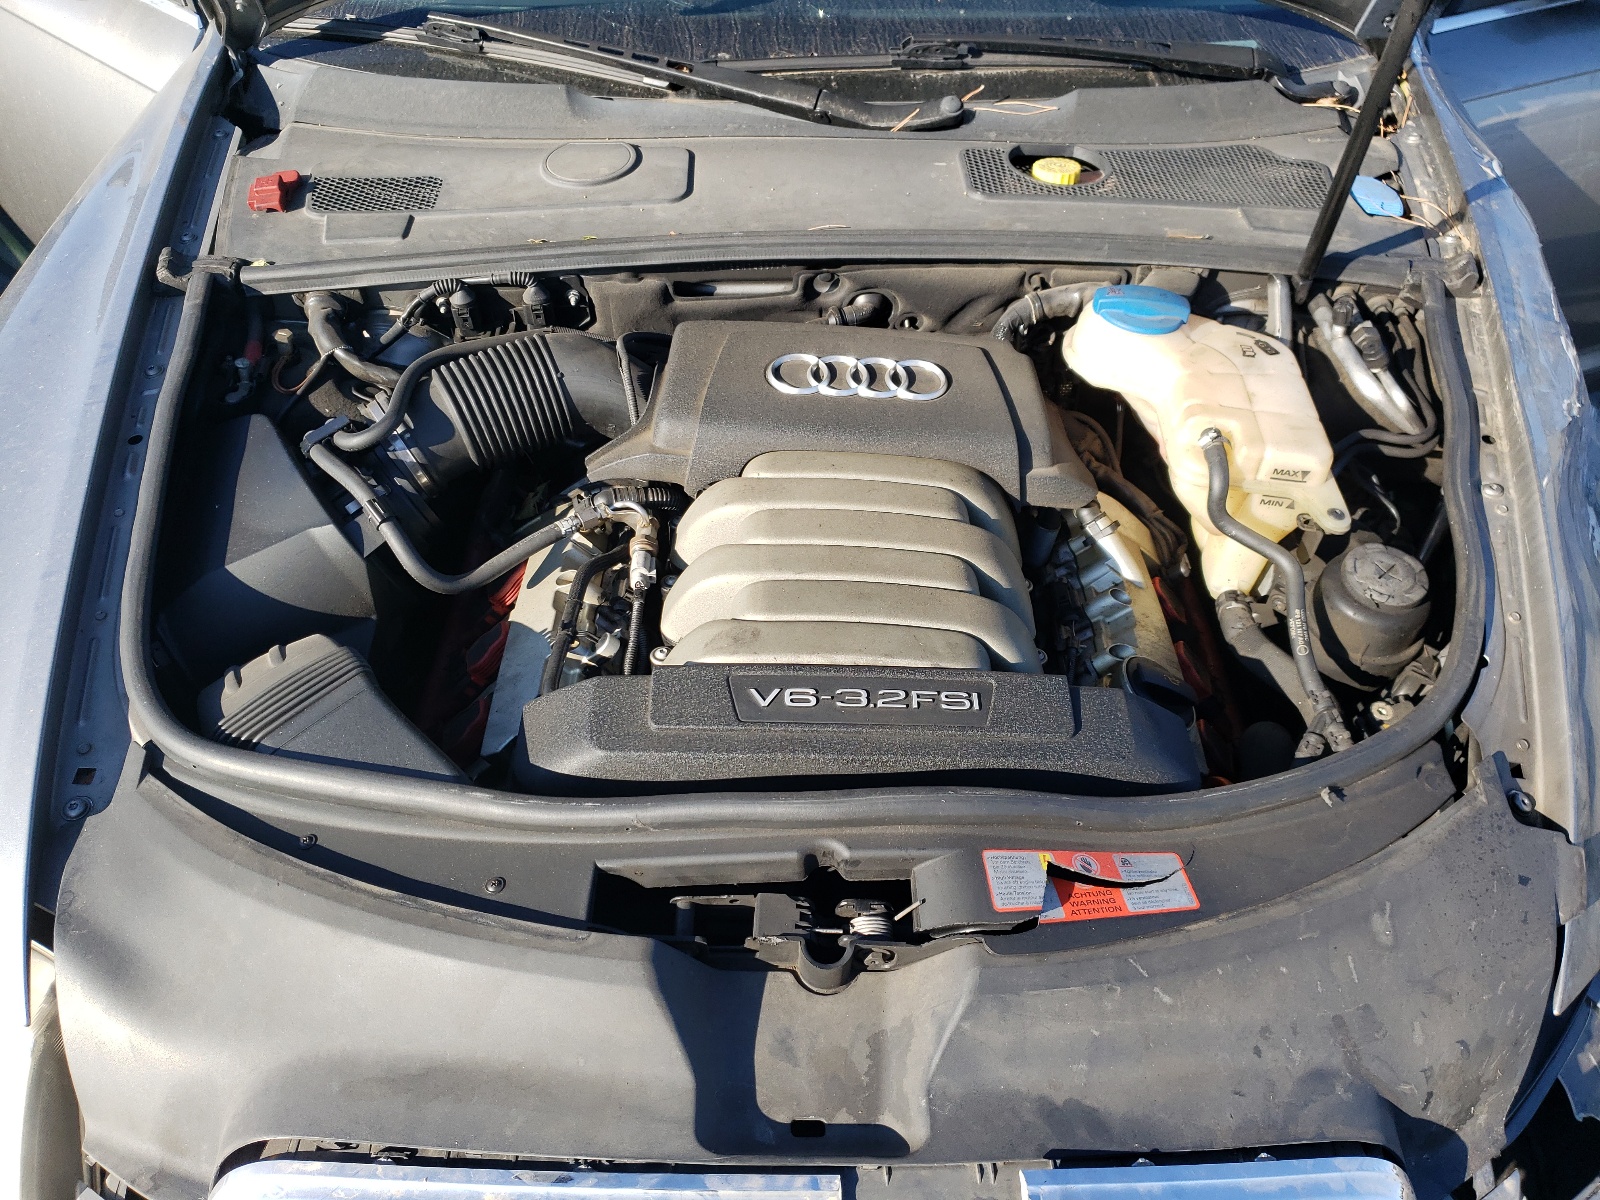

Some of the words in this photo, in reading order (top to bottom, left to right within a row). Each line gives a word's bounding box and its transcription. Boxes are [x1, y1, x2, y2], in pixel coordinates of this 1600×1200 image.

[1272, 468, 1300, 478] MAX
[1259, 498, 1284, 507] MIN
[1068, 889, 1113, 899] ACHTUNG
[1069, 897, 1117, 907] WARNING
[1070, 905, 1123, 916] ATTENTION
